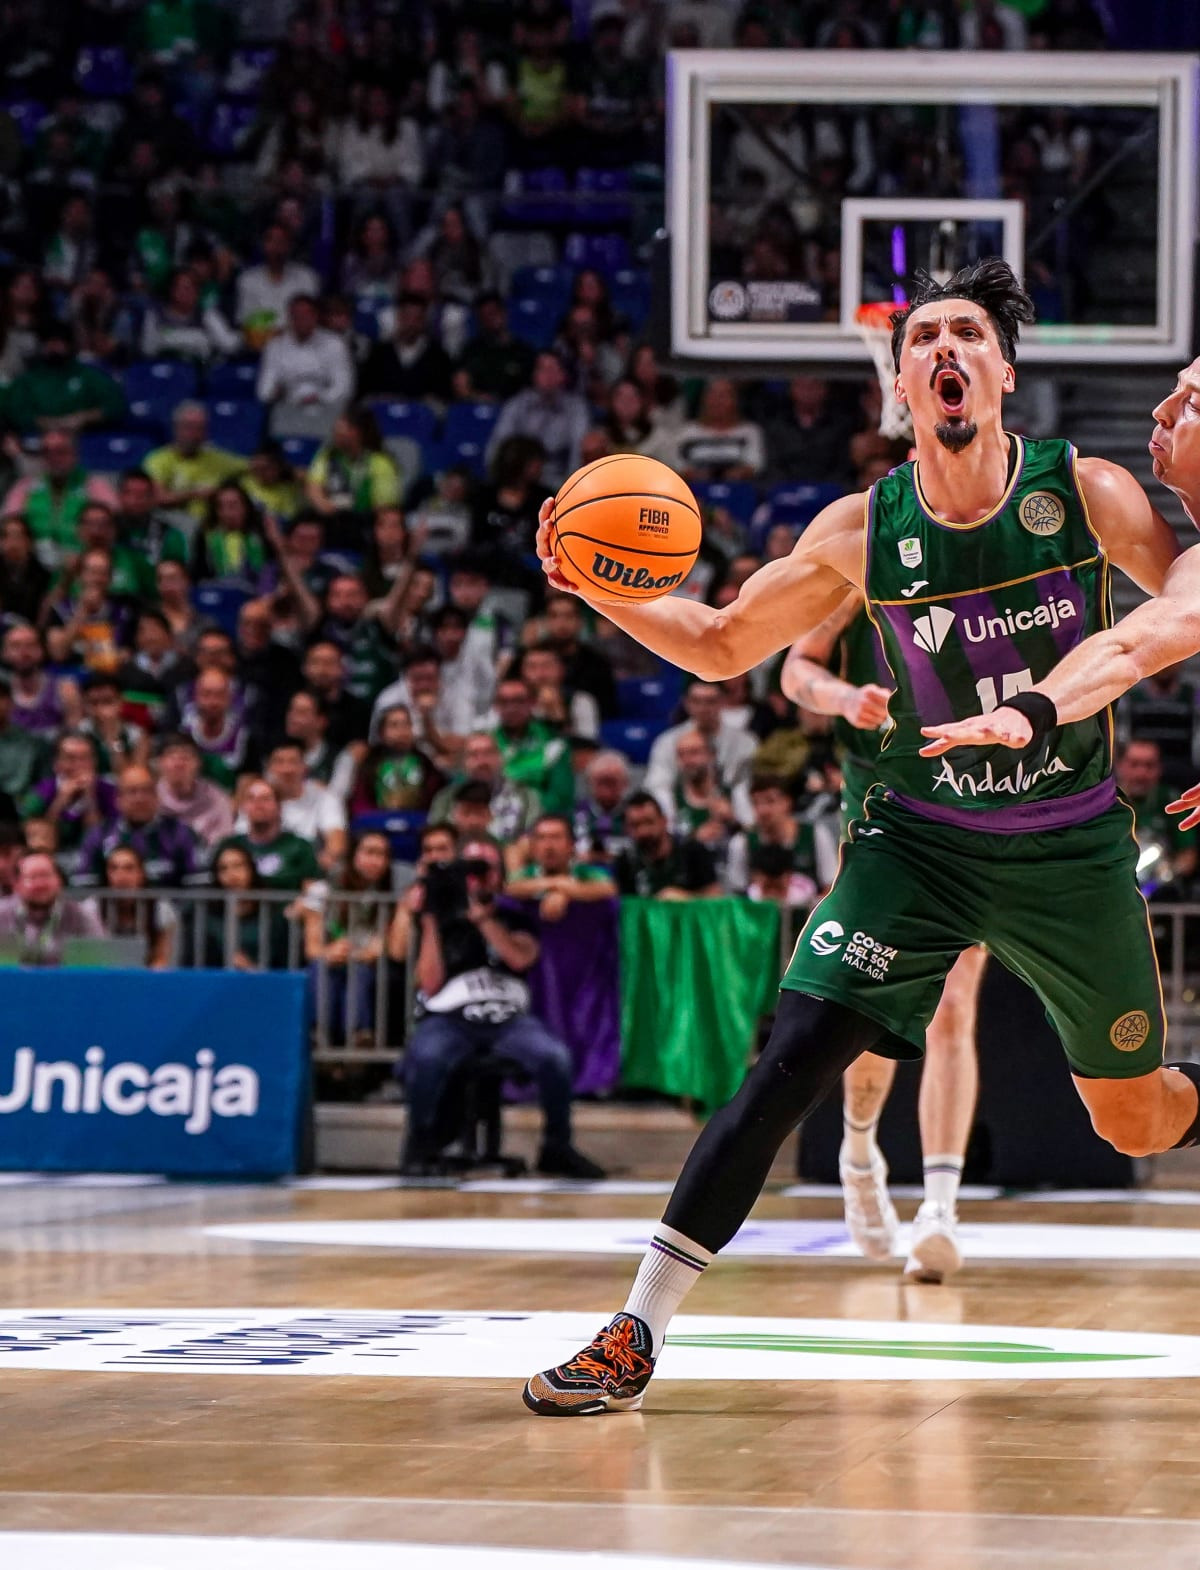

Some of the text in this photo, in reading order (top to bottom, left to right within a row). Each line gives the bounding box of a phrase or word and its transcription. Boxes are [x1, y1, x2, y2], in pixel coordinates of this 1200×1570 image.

[638, 525, 669, 534] APPROVED
[639, 508, 669, 526] FIBA
[592, 552, 683, 589] Wilson
[963, 596, 1077, 643] Unicaja
[846, 941, 889, 972] DEL SOL
[852, 931, 899, 960] COSTA
[841, 953, 885, 982] MÁLAGA
